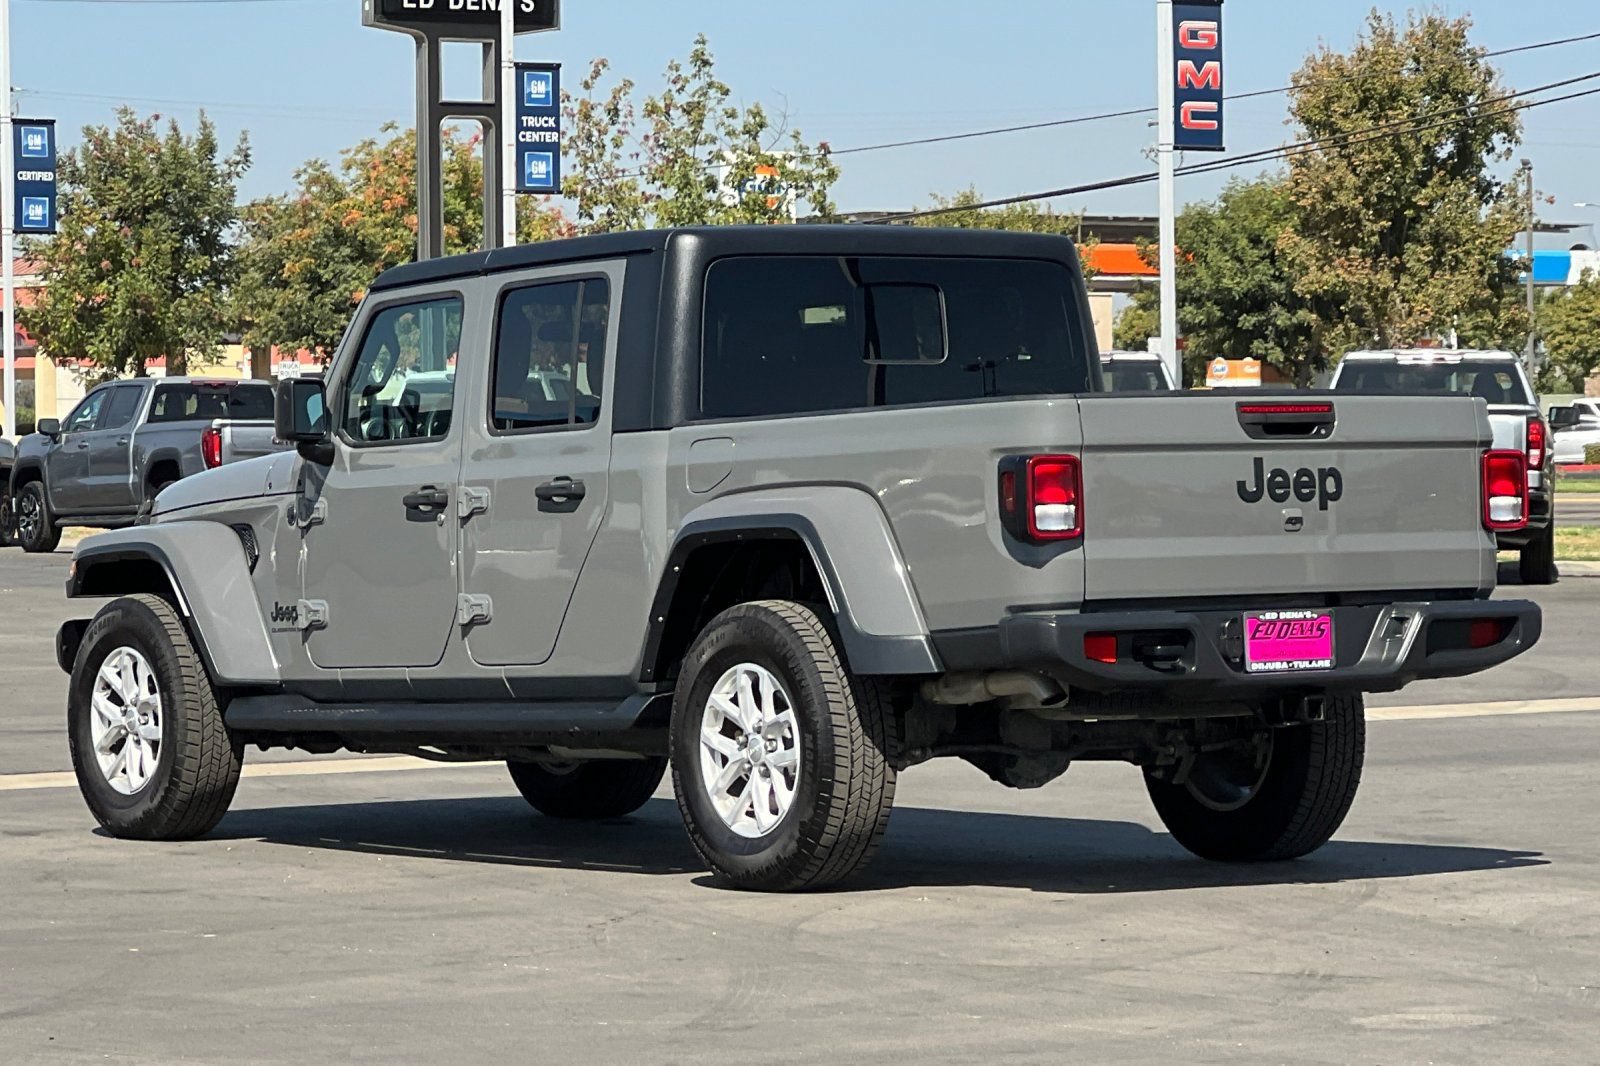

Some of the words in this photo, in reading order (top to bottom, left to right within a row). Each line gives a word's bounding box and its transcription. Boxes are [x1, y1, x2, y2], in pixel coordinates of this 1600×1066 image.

[1177, 20, 1221, 131] GMC
[530, 80, 546, 94] GM
[521, 116, 556, 127] TRUCK
[27, 134, 42, 146] GM
[518, 131, 559, 142] CENTER
[531, 160, 547, 174] GM
[17, 170, 54, 181] CERTIFIED
[28, 204, 43, 217] GM
[1236, 456, 1343, 511] Jeep
[270, 601, 298, 625] Jeep
[1265, 612, 1278, 620] ED
[1249, 622, 1277, 640] ED
